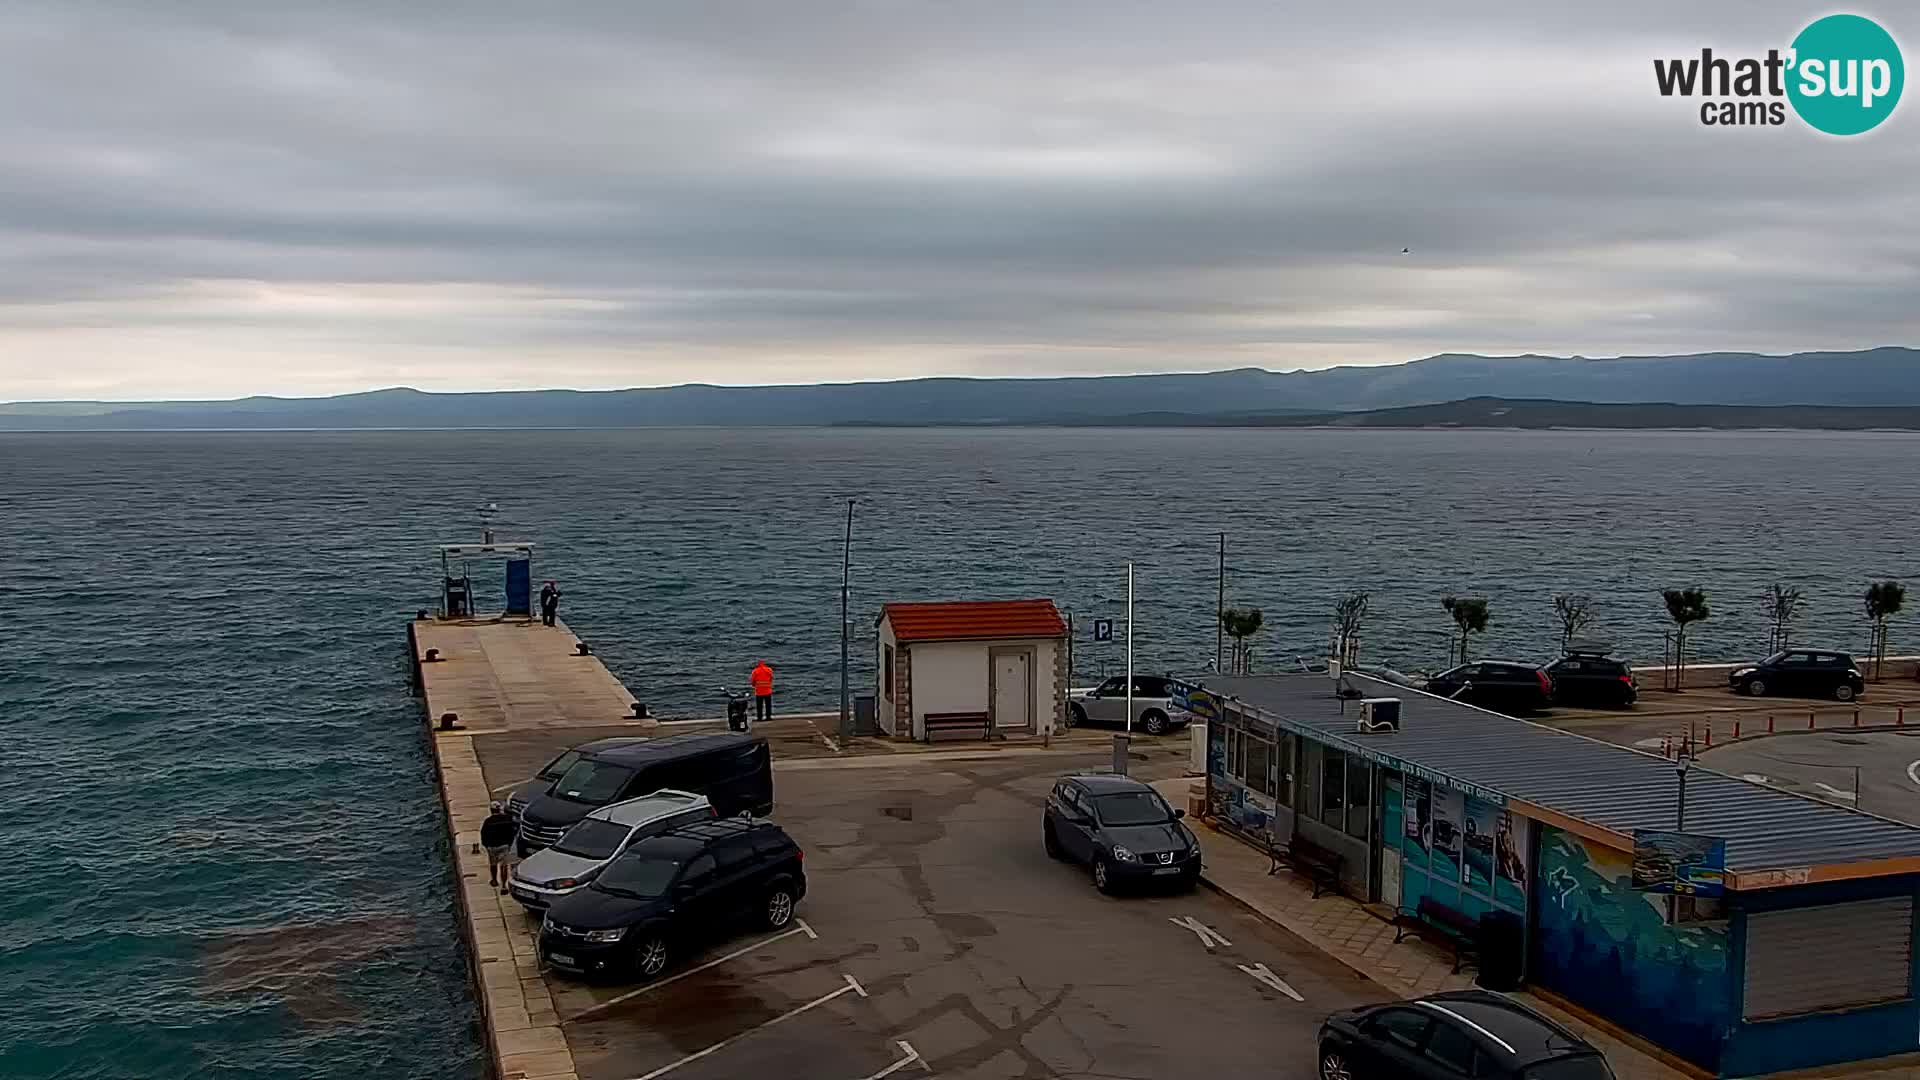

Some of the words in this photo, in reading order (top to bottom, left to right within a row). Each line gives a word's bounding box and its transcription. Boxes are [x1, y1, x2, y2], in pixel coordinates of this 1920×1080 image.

[1098, 621, 1109, 639] P
[1415, 767, 1447, 785] STATION
[1449, 778, 1474, 795] TICKET
